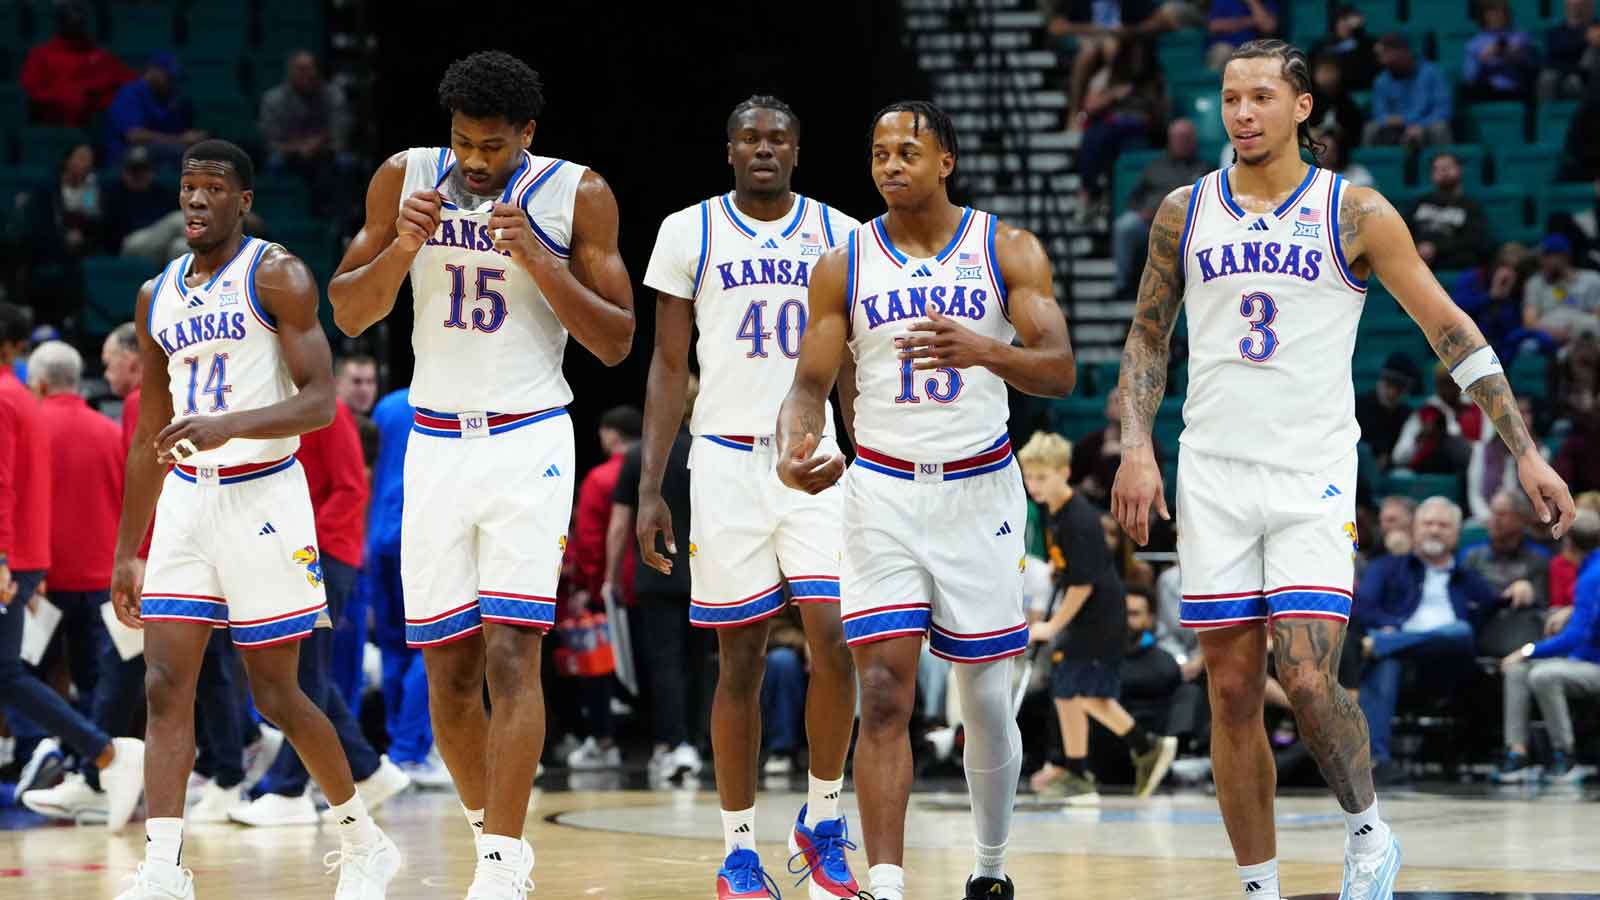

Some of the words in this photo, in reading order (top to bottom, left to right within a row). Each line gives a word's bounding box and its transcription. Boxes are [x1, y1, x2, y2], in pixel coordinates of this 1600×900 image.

[716, 258, 809, 291] KANSA
[1195, 241, 1323, 283] KANSAS
[444, 264, 509, 334] 15
[861, 285, 988, 330] KANSAS
[157, 311, 247, 356] KANSAS
[736, 298, 808, 360] 40
[1239, 291, 1280, 363] 3
[183, 353, 233, 416] 14
[465, 416, 483, 429] KU
[919, 463, 937, 475] KU
